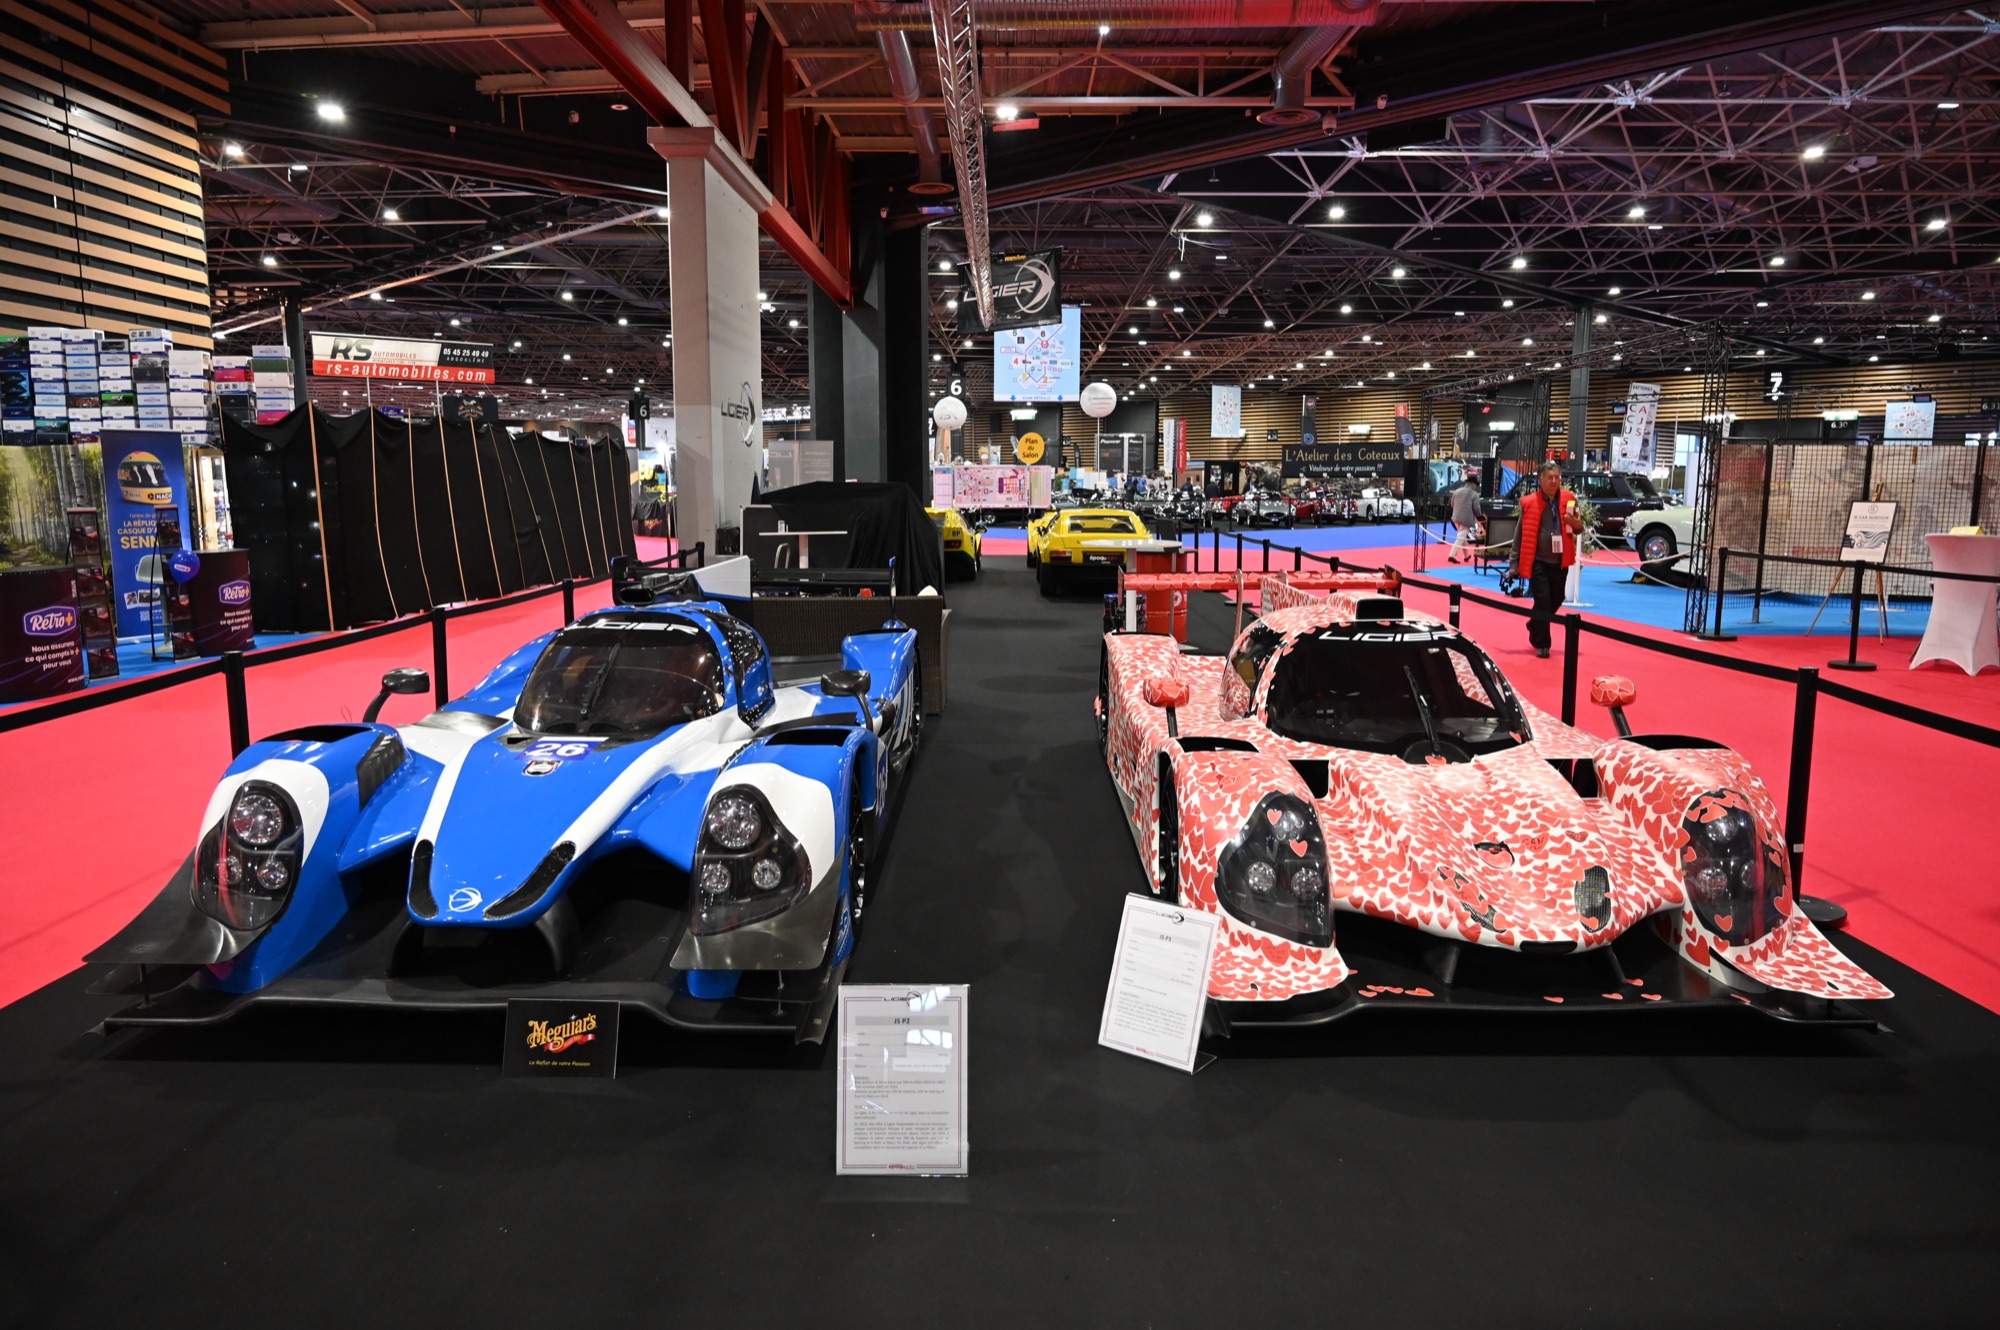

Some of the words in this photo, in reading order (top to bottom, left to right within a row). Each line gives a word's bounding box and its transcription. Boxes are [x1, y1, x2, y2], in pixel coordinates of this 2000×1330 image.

[963, 280, 1037, 302] LGIER
[330, 337, 373, 361] RS
[373, 351, 417, 360] AUTOMOBILES
[443, 348, 451, 356] 05
[462, 349, 471, 357] 25
[326, 362, 487, 382] rs-automobiles.com
[950, 379, 962, 396] 6
[1770, 377, 1783, 393] 7
[639, 405, 648, 417] 6
[1285, 448, 1329, 462] L'Atelier
[1334, 448, 1352, 461] des
[1358, 448, 1400, 461] Coteaux
[1355, 465, 1376, 473] passion
[133, 519, 157, 527] RÉPLIQ
[120, 536, 160, 549] SENN
[223, 585, 250, 601] Retro+
[30, 612, 73, 632] Retro+
[566, 621, 699, 635] LIGIER
[1318, 631, 1457, 642] LIGIER
[32, 644, 50, 653] Nous
[50, 640, 75, 650] assurons
[35, 654, 47, 663] qui
[48, 650, 69, 660] compte
[43, 661, 58, 671] pour
[525, 742, 589, 757] 26
[527, 1013, 597, 1051] Meguiar's
